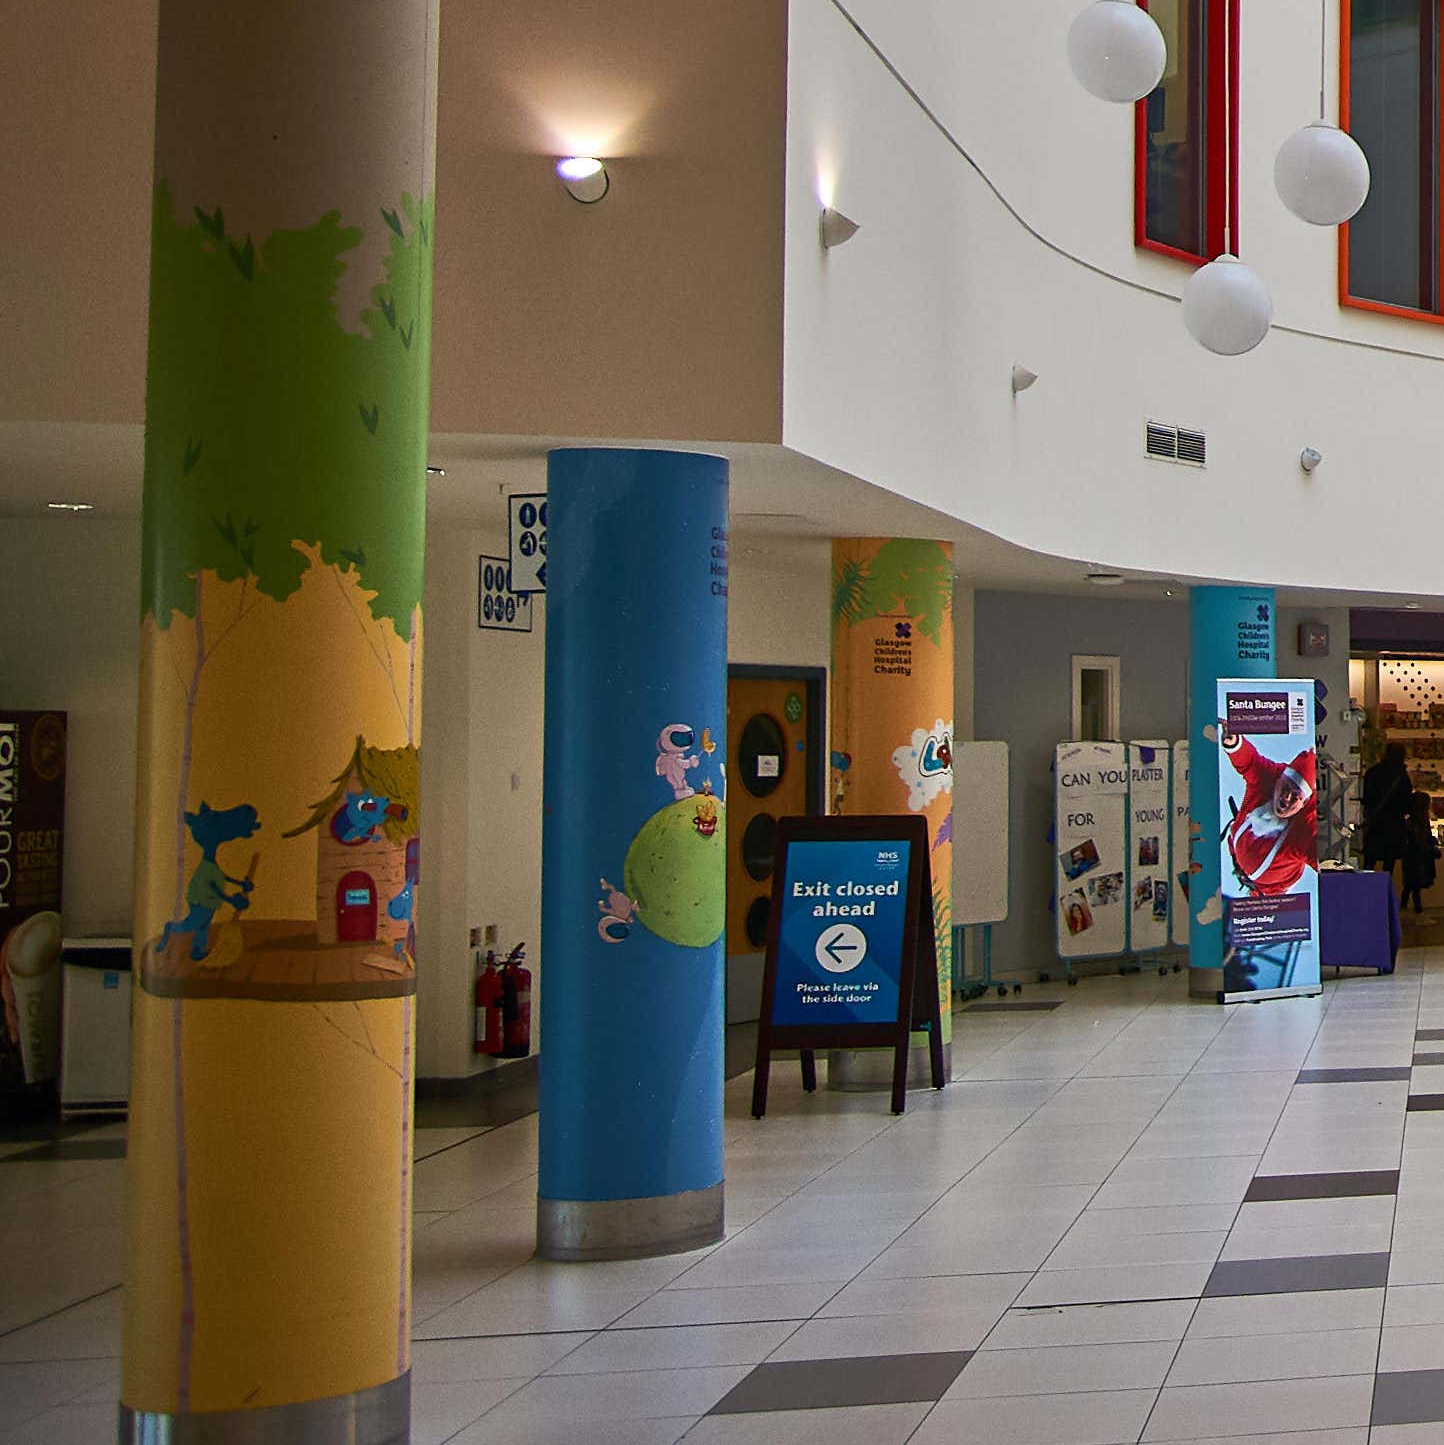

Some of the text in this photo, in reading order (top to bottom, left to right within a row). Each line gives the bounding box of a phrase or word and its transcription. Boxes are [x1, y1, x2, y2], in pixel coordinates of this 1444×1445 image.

[875, 638, 912, 648] Glasgow
[873, 656, 912, 665] Hospital
[873, 665, 912, 677] Charity
[1228, 699, 1287, 712] Santa Bungee
[1061, 768, 1165, 787] CAN YOU PLASTER
[1067, 812, 1096, 827] FOR
[1135, 808, 1165, 823] YOUNG
[878, 851, 899, 859] NHS
[793, 880, 899, 897] Exit closed
[812, 901, 876, 917] ahead
[796, 982, 879, 992] Please leave via
[802, 994, 872, 1004] the side door
